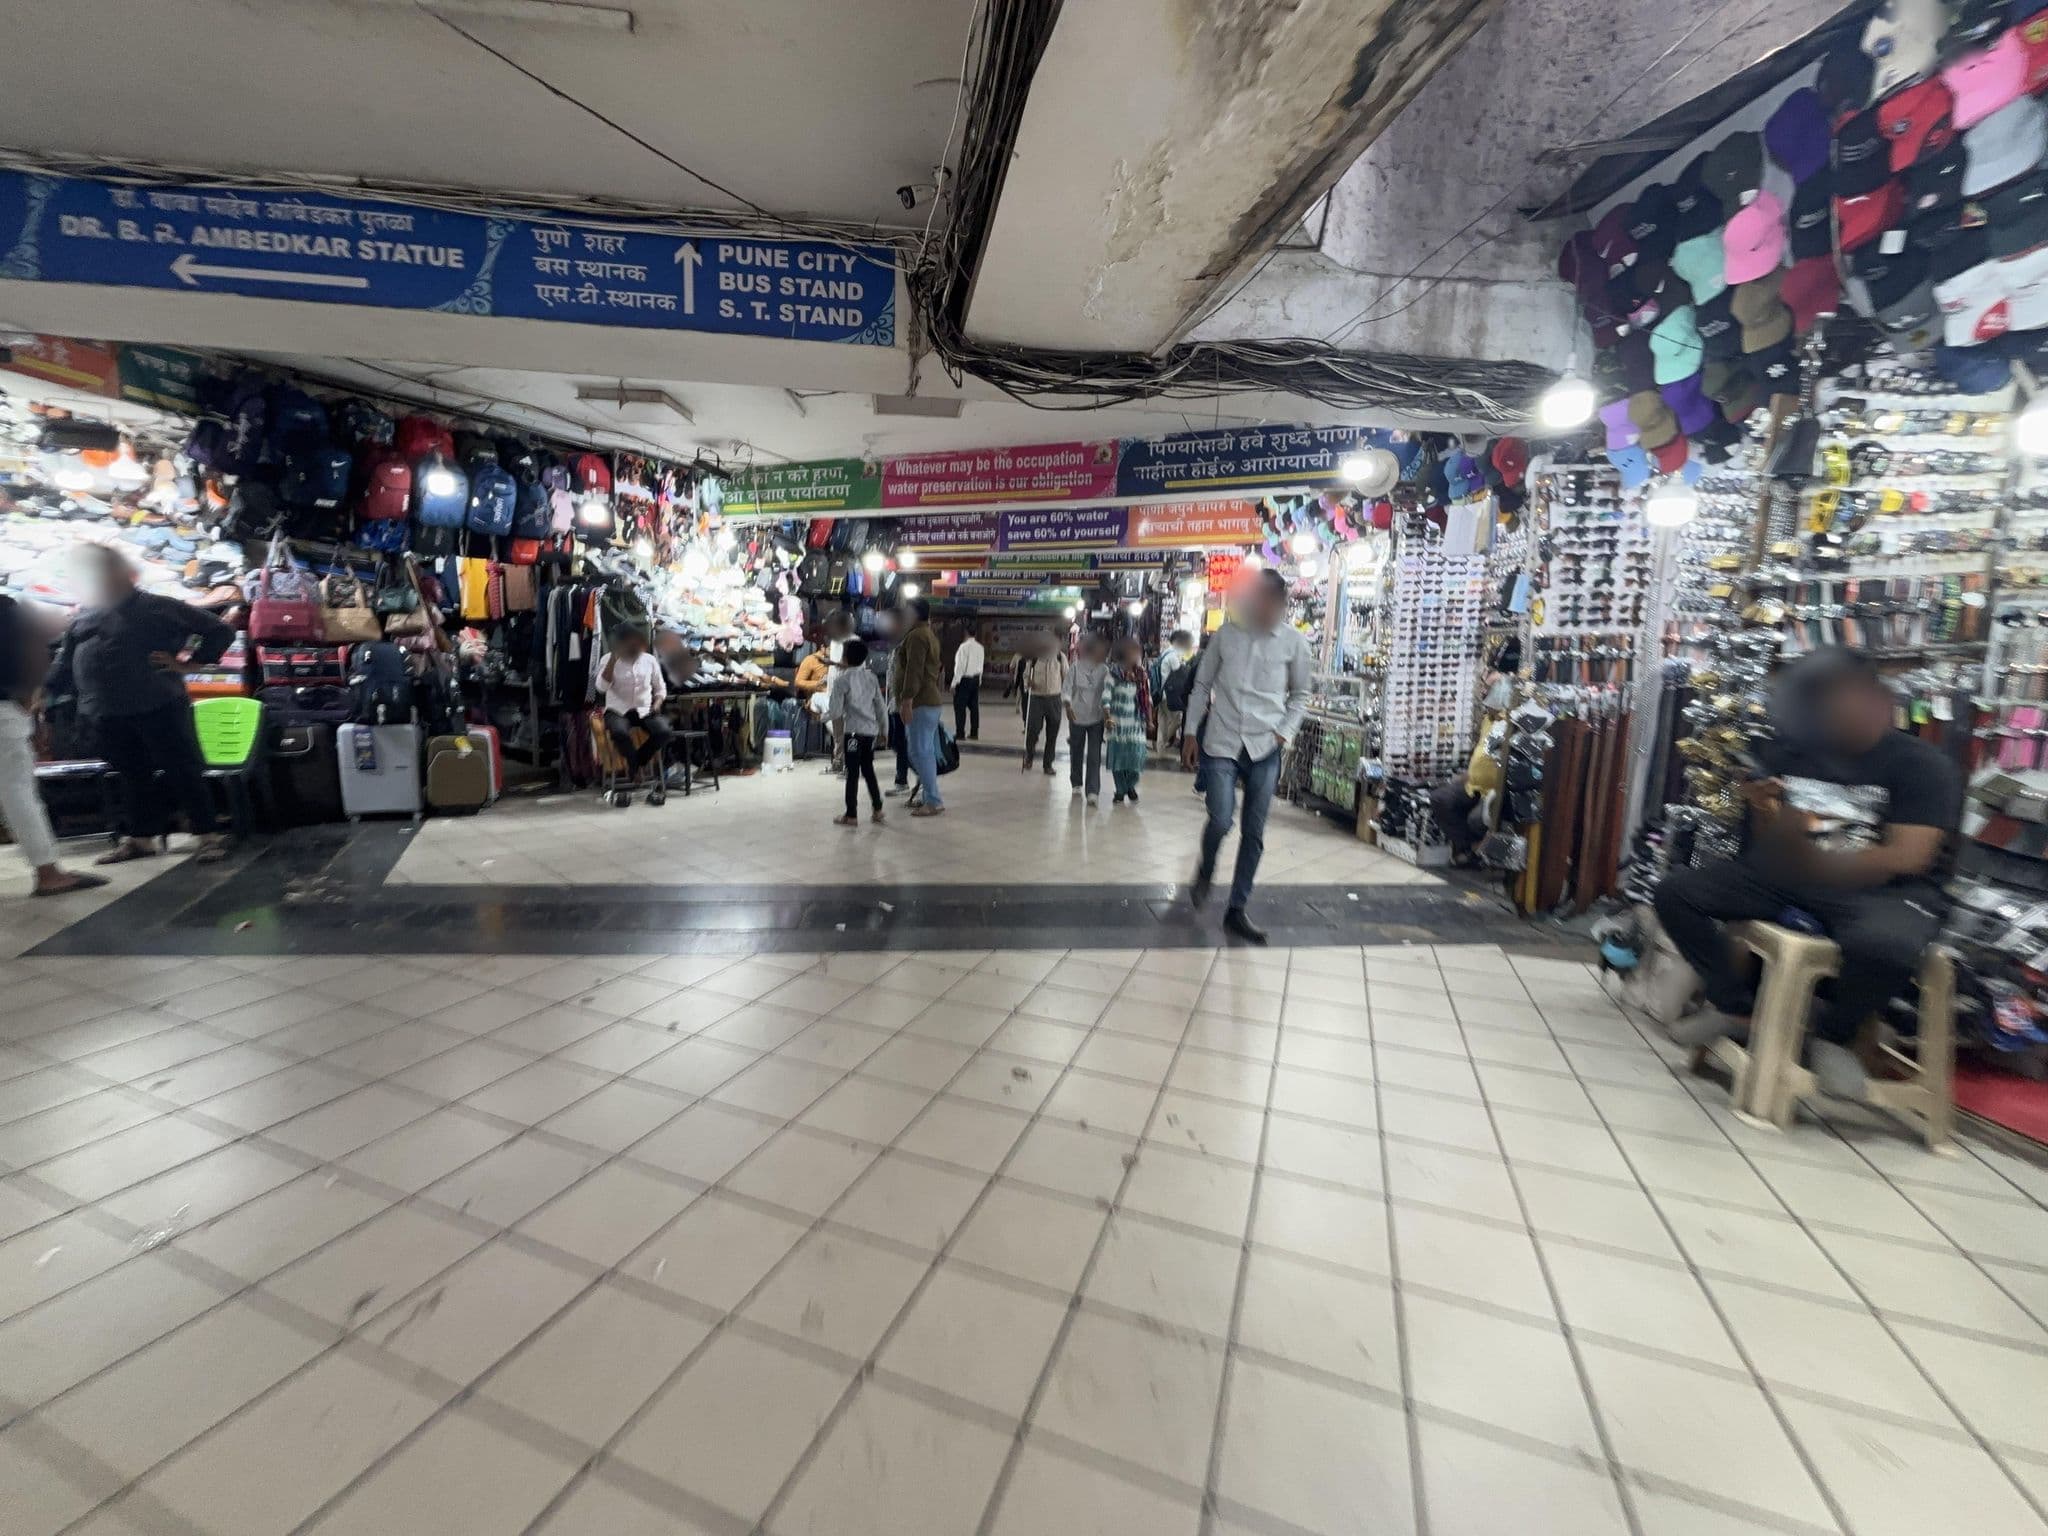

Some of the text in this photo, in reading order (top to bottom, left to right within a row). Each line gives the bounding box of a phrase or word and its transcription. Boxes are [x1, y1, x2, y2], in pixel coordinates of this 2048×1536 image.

[59, 214, 110, 240] DR.
[117, 219, 148, 243] B.
[190, 225, 353, 260] AMBEDKAR
[357, 239, 465, 269] STATUE
[530, 225, 627, 256] पुणे शहर
[531, 255, 649, 283] बस स्थानक
[717, 243, 859, 276] PUNE CITY
[718, 271, 864, 301] BUS STAND
[718, 298, 863, 328] S. T. STAND
[1148, 431, 1236, 457] पिण्यासाठी
[1239, 429, 1266, 450] हवे
[773, 470, 784, 484] न
[895, 450, 1085, 476] Whatever may be the occupation
[1133, 460, 1187, 482] नाहीतर
[1189, 455, 1236, 479] होईल
[1240, 447, 1333, 474] आरोग्याची
[788, 481, 851, 500] पर्यावरण
[888, 470, 1093, 496] water preservation is our obligation
[1007, 510, 1109, 526] You are 60% water
[1187, 519, 1214, 533] तहान
[1007, 524, 1121, 541] save 60% of yourself
